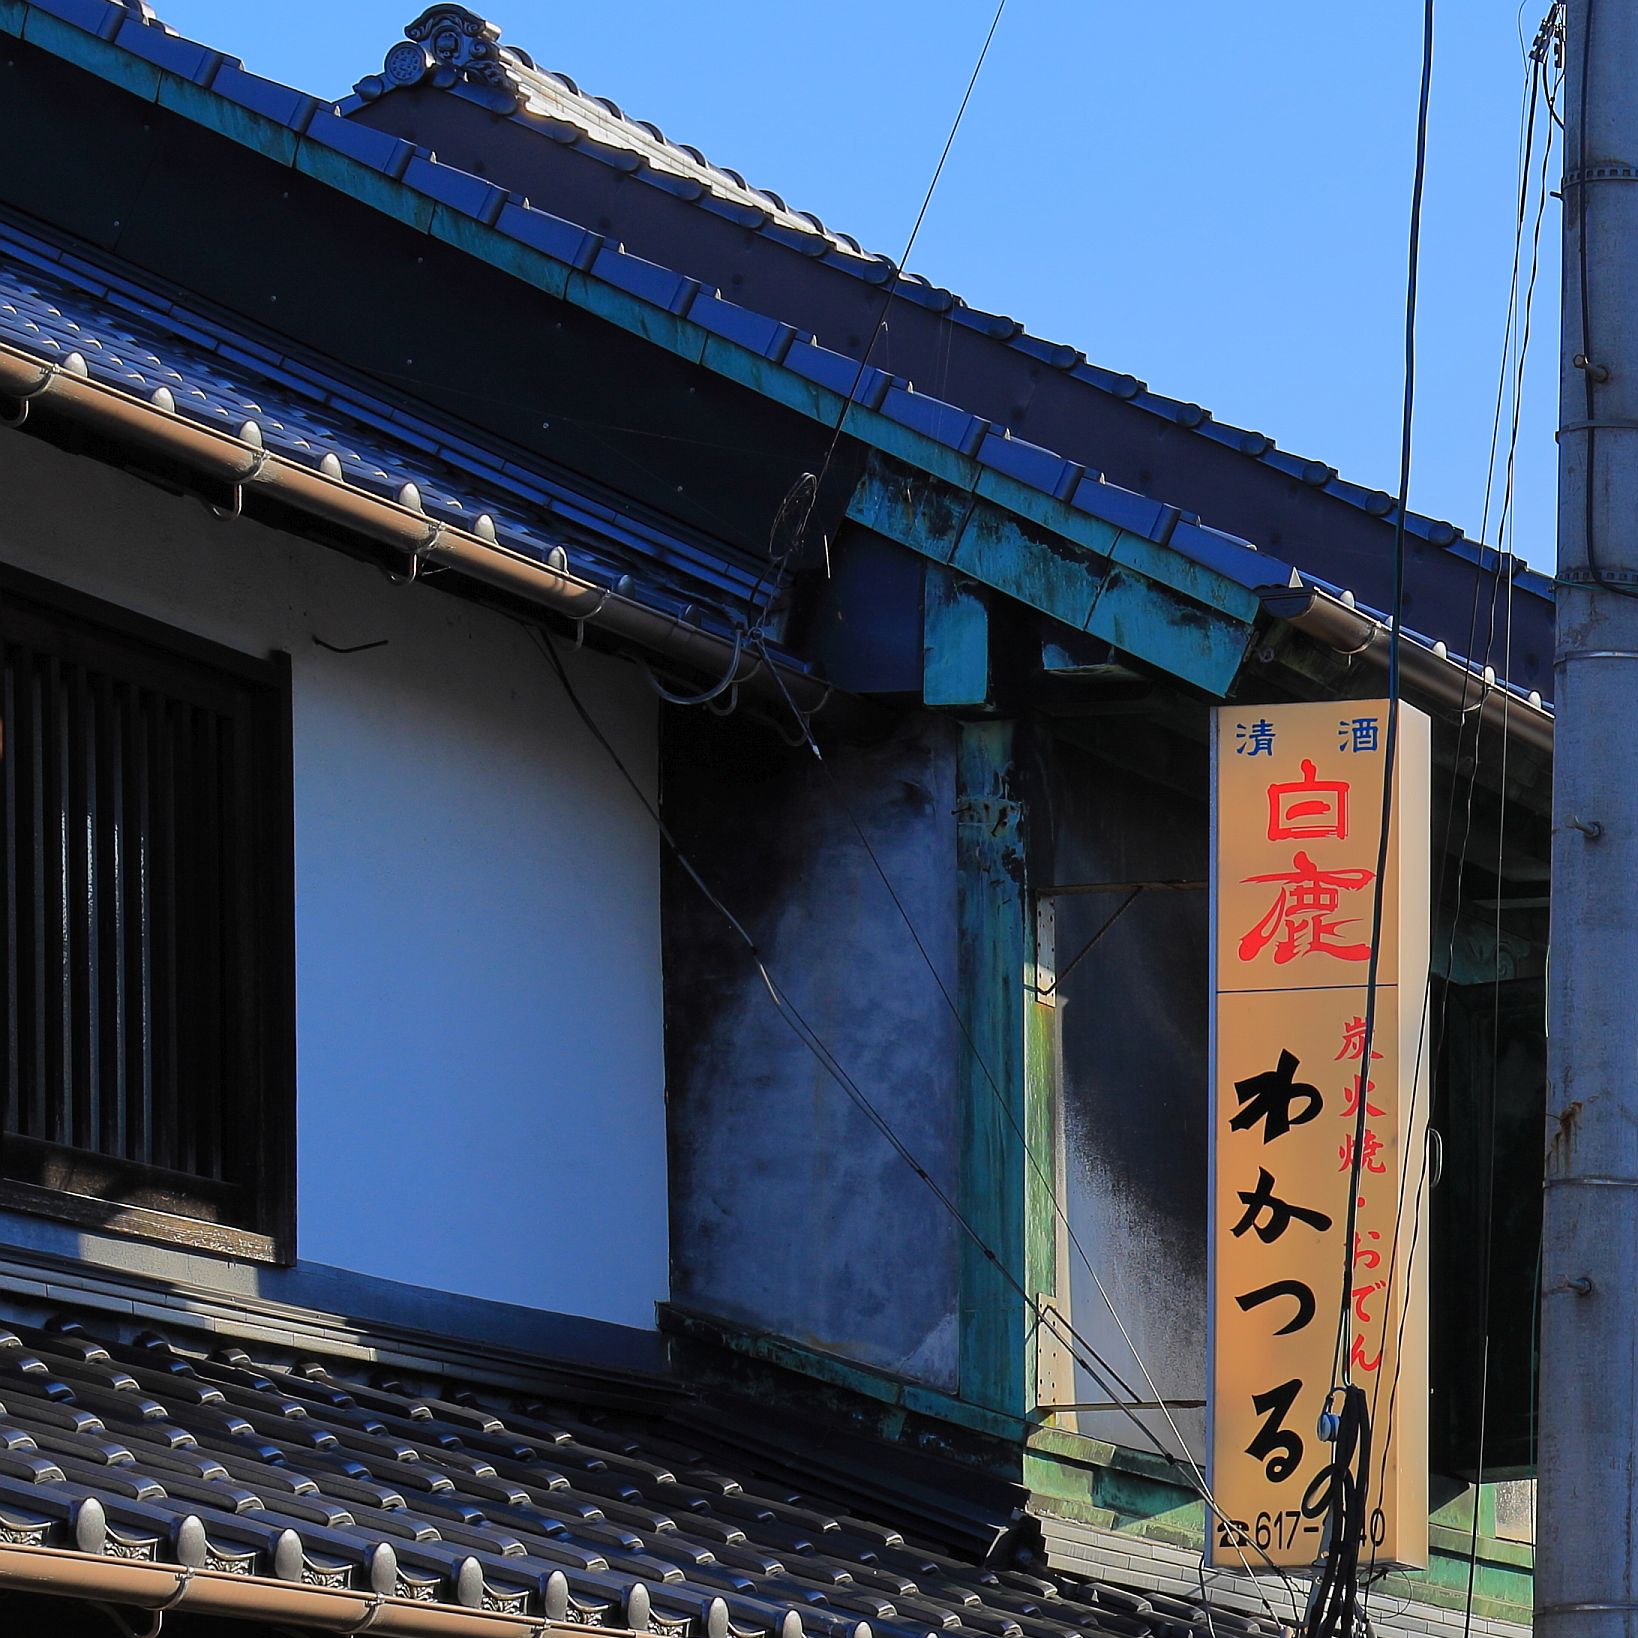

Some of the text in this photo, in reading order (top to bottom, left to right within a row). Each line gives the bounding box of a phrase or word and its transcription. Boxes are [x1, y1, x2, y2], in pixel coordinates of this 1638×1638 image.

[1238, 758, 1378, 964] 白鹿
[1229, 1047, 1333, 1484] わかつる
